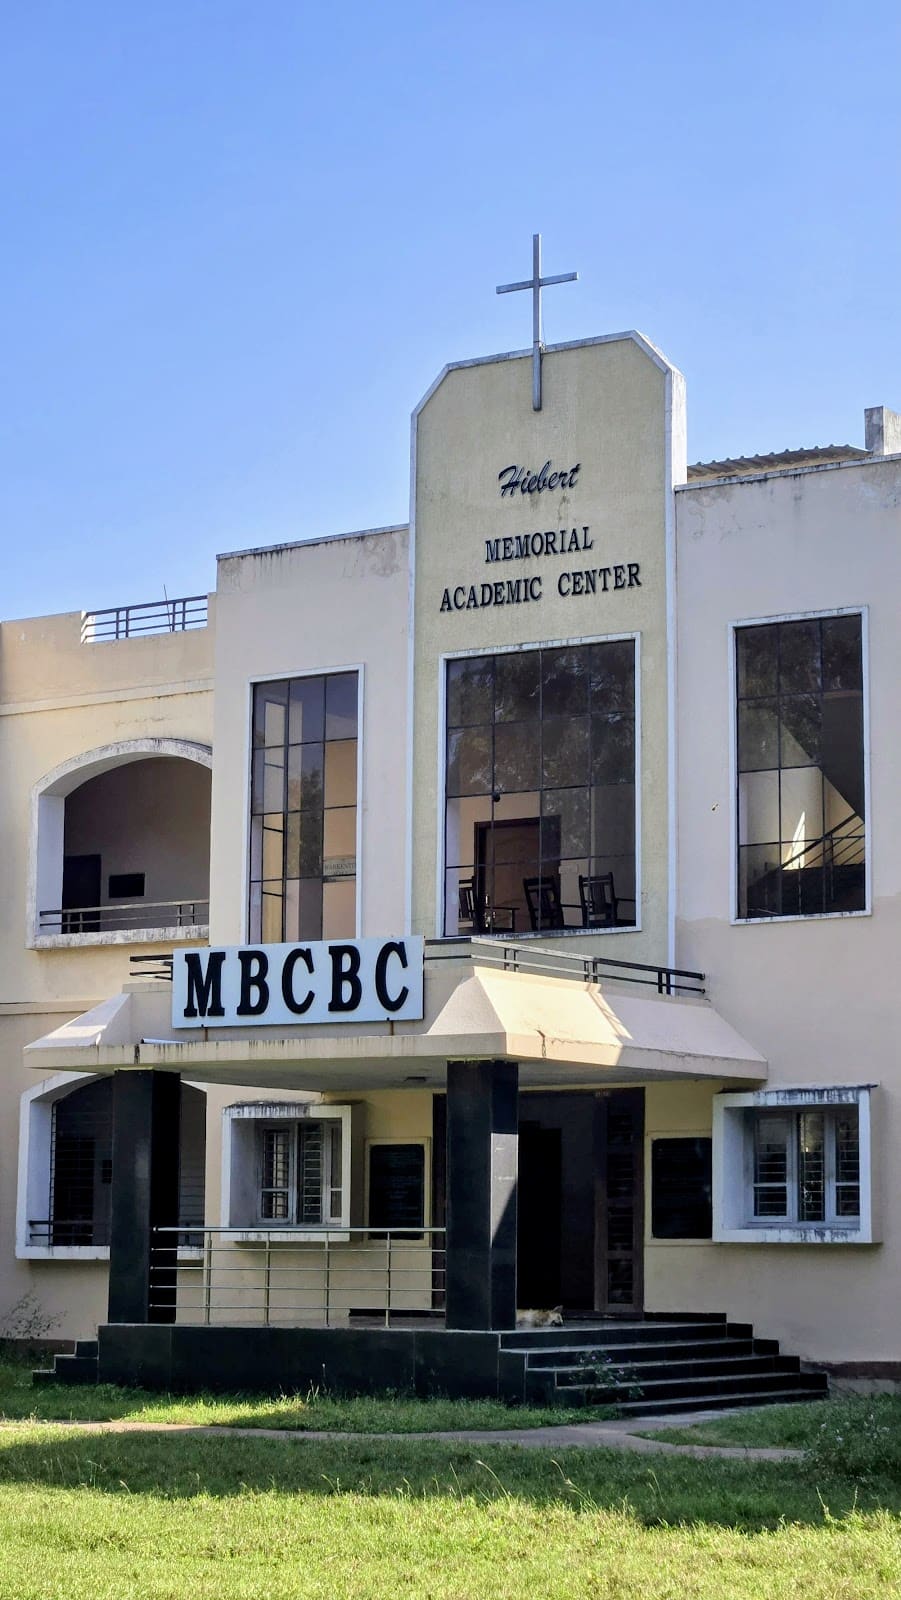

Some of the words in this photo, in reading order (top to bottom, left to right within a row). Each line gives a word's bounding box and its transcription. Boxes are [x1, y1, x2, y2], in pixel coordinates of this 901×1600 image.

[498, 460, 581, 497] Hiebert
[485, 526, 594, 564] MEMORIAL
[440, 576, 544, 612] ACADEMIC
[557, 563, 642, 597] CENTER
[184, 941, 409, 1018] MBCBC
